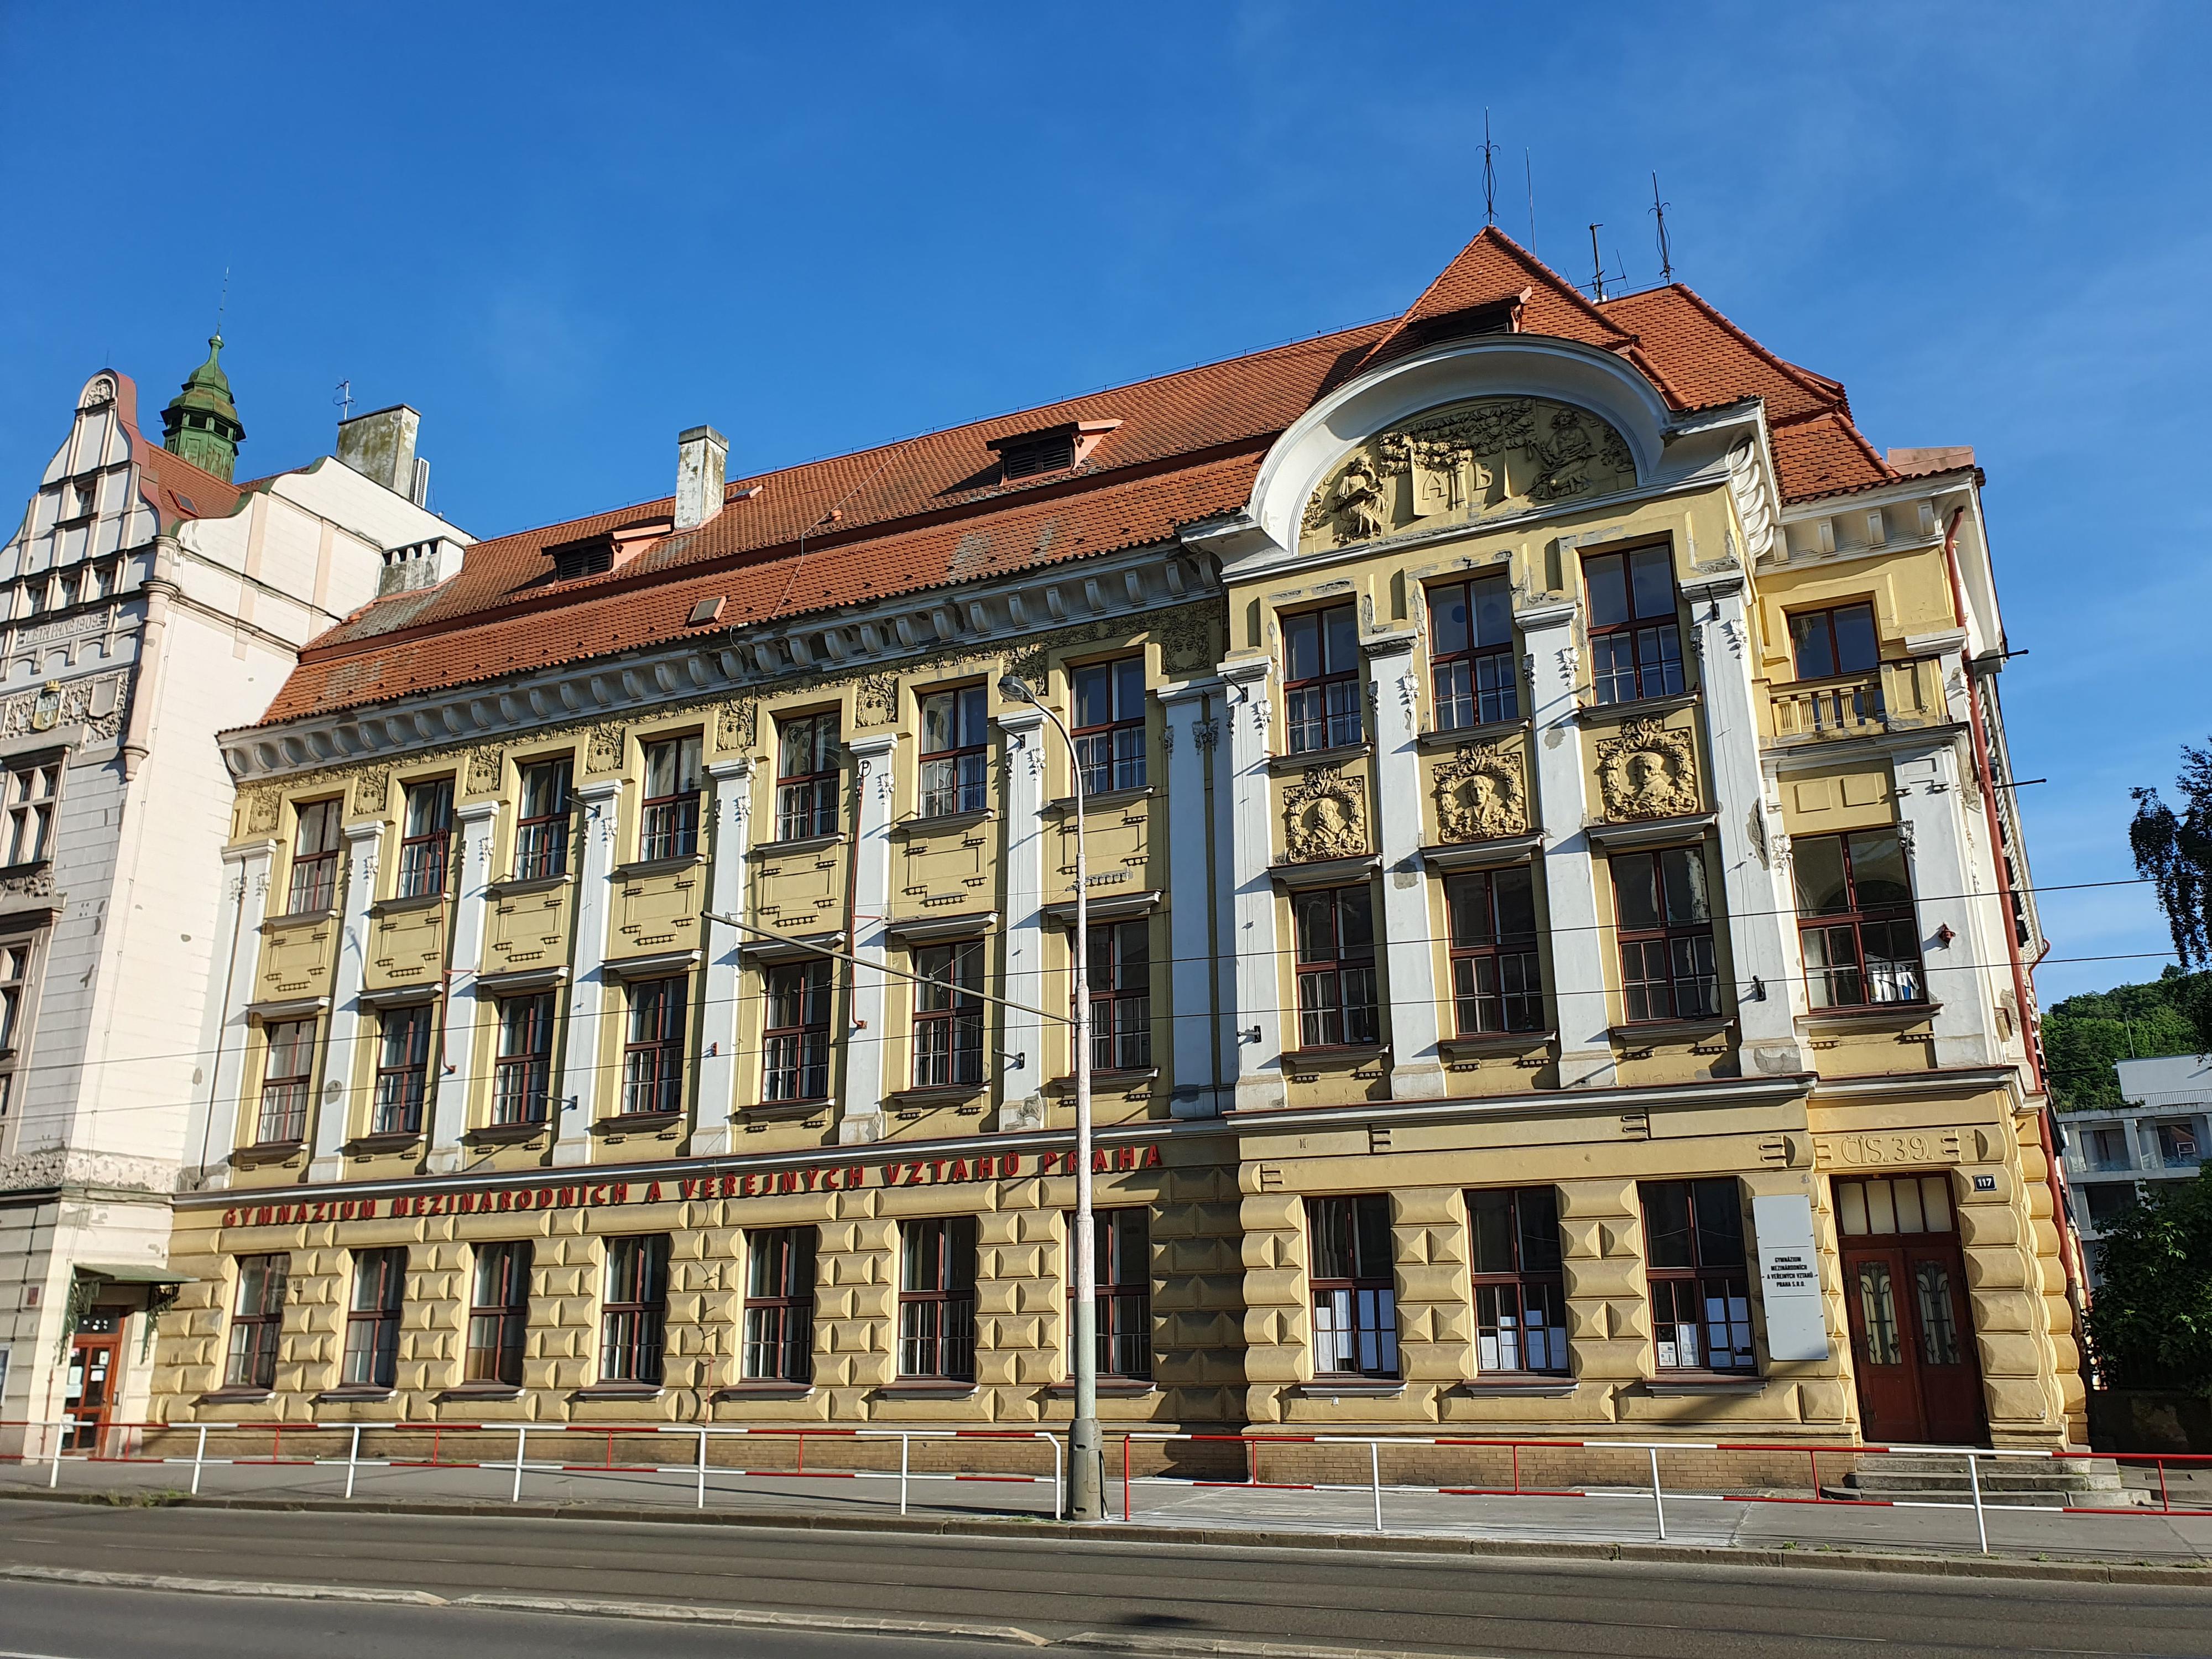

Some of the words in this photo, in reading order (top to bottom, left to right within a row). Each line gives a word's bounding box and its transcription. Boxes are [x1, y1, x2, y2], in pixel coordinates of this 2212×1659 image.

[76, 614, 99, 632] 1909
[222, 1199, 377, 1225] GYMNÁZIUM
[392, 1181, 628, 1214] MEZINÁRODNÍCH
[649, 1180, 662, 1200] A
[683, 1165, 865, 1198] VEŘEJNÝCH
[886, 1150, 1020, 1183] VZTAHŮ
[1977, 1177, 1992, 1187] 117
